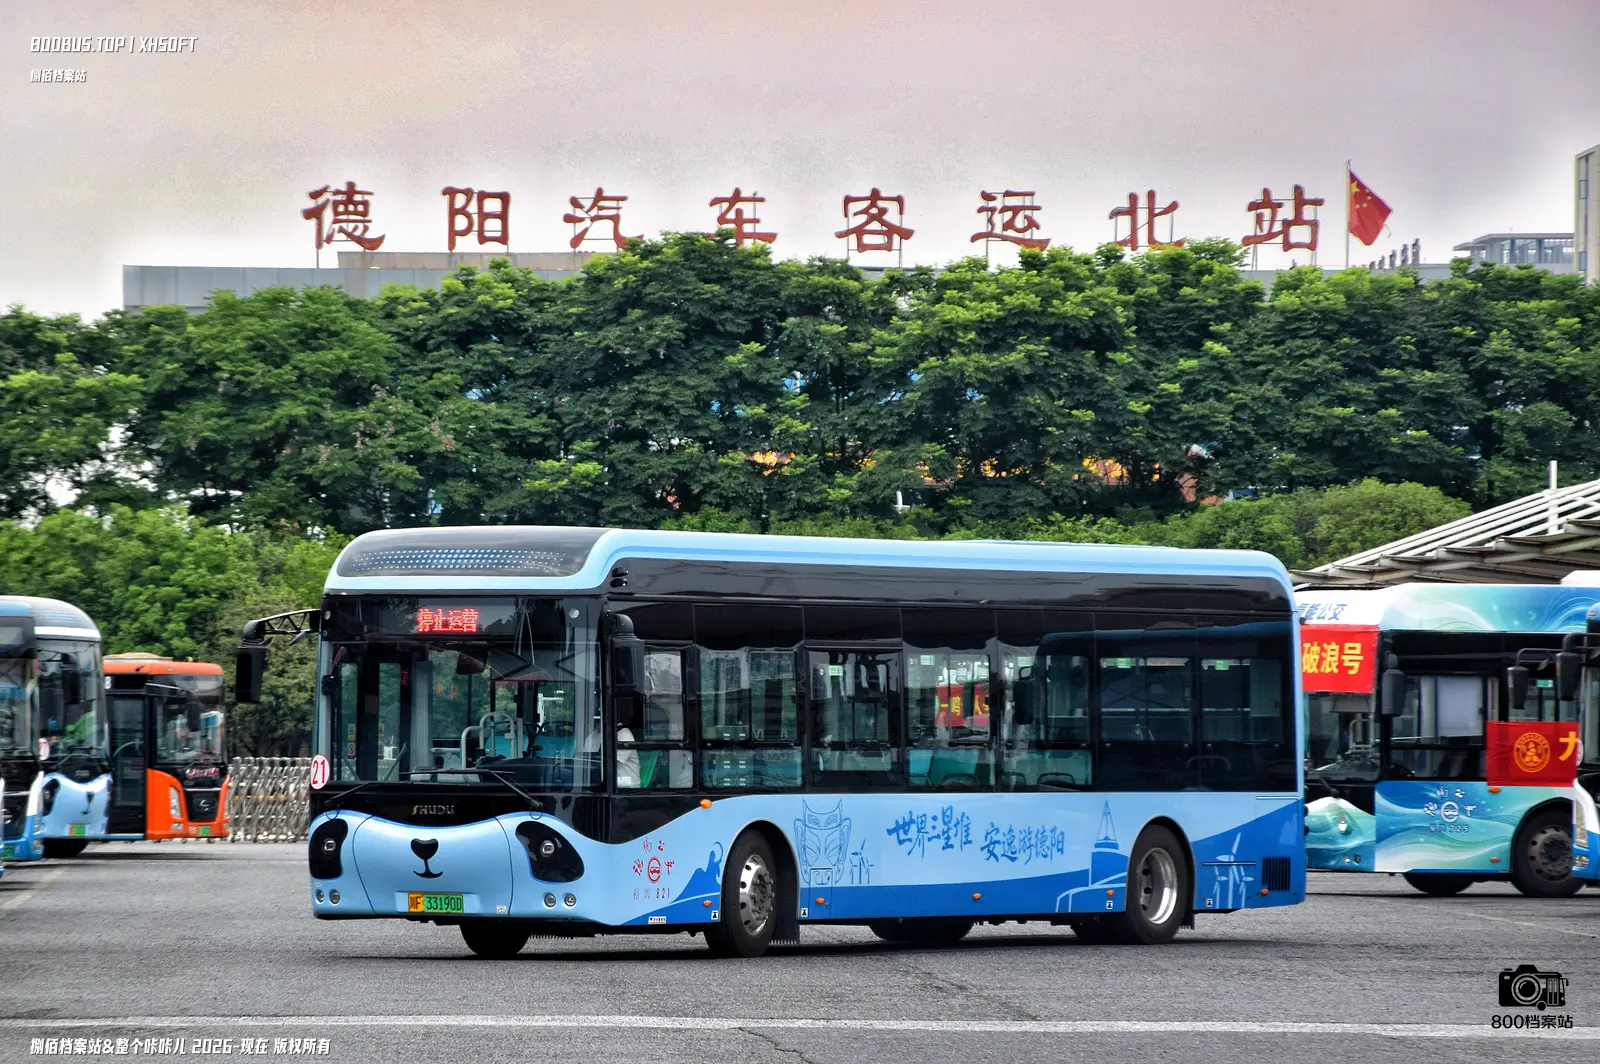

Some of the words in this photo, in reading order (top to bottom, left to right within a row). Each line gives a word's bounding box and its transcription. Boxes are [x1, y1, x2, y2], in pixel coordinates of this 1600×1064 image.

[302, 180, 1325, 251] 德阳汽车客运北站
[416, 608, 478, 633] 停止运营
[1302, 641, 1364, 674] 破浪号
[312, 758, 326, 785] 21
[411, 804, 455, 816] SHUDU
[886, 805, 973, 862] 世界三星堆
[980, 822, 1065, 865] 安逸游德阳
